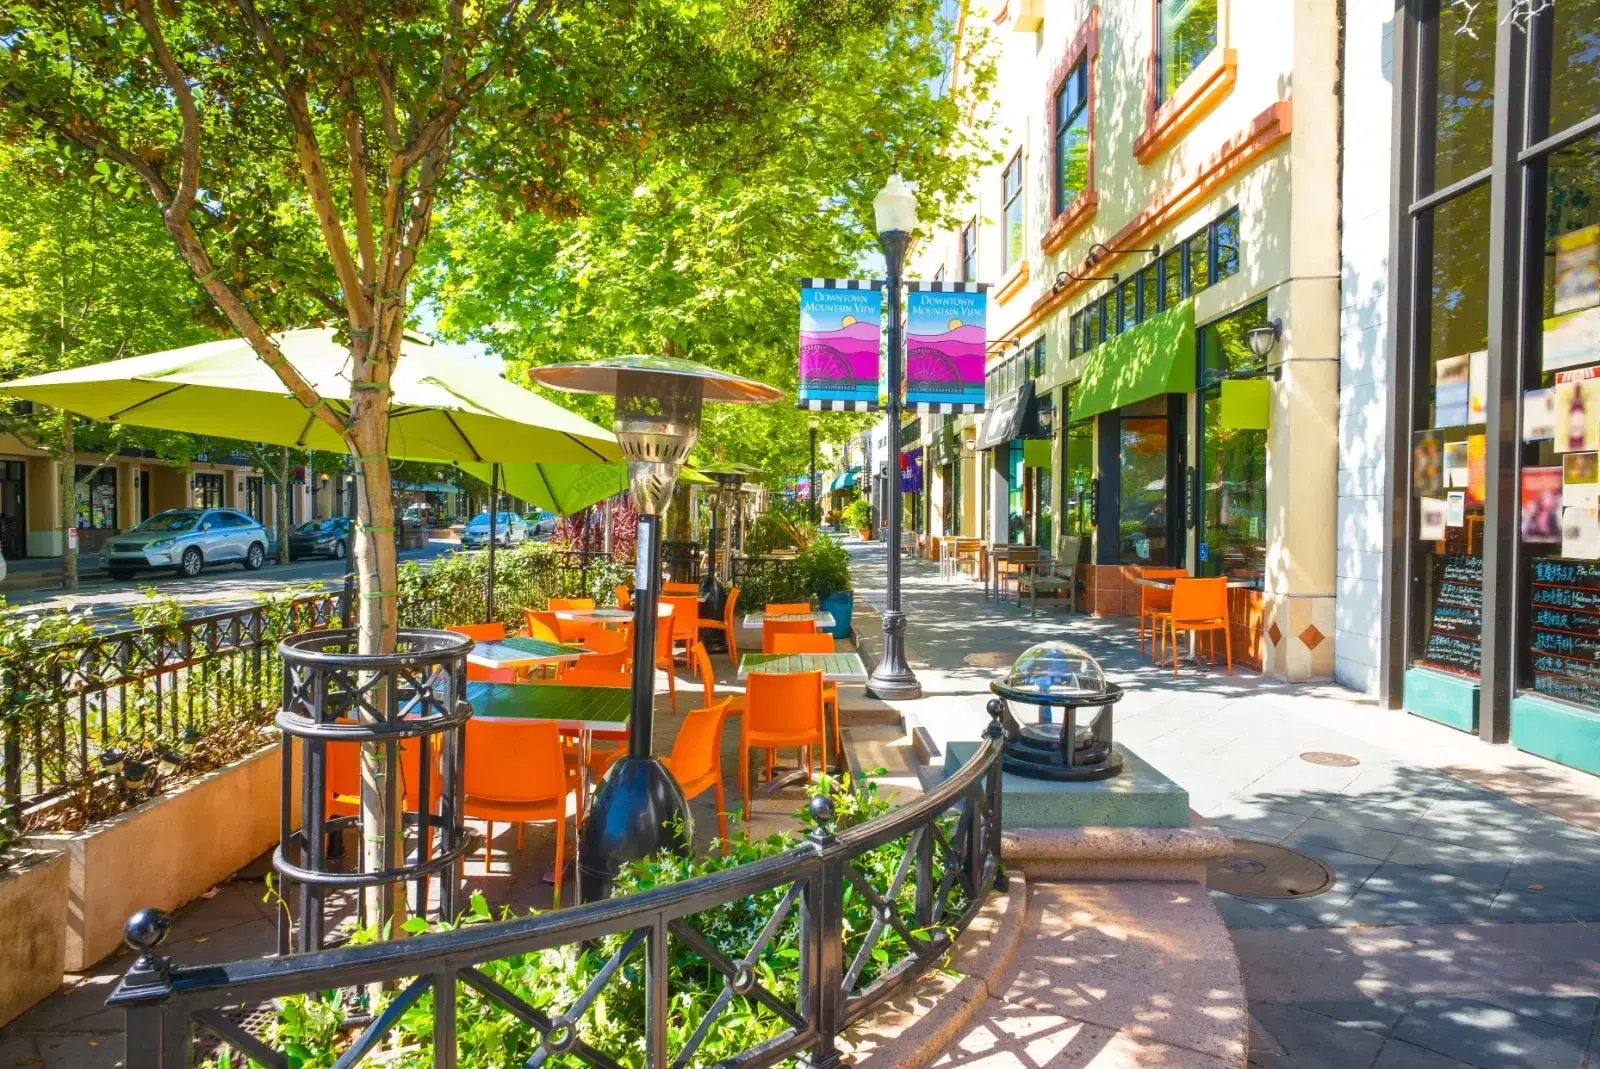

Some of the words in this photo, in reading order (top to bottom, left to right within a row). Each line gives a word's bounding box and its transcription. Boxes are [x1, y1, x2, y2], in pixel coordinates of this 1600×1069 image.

[814, 291, 868, 303] DOWNTOWN
[921, 295, 975, 306] DOWNTOWN
[805, 302, 852, 313] MOUNTAIN
[854, 303, 877, 313] VIEW
[912, 305, 959, 316] MOUNTAIN
[960, 306, 982, 317] VIEW
